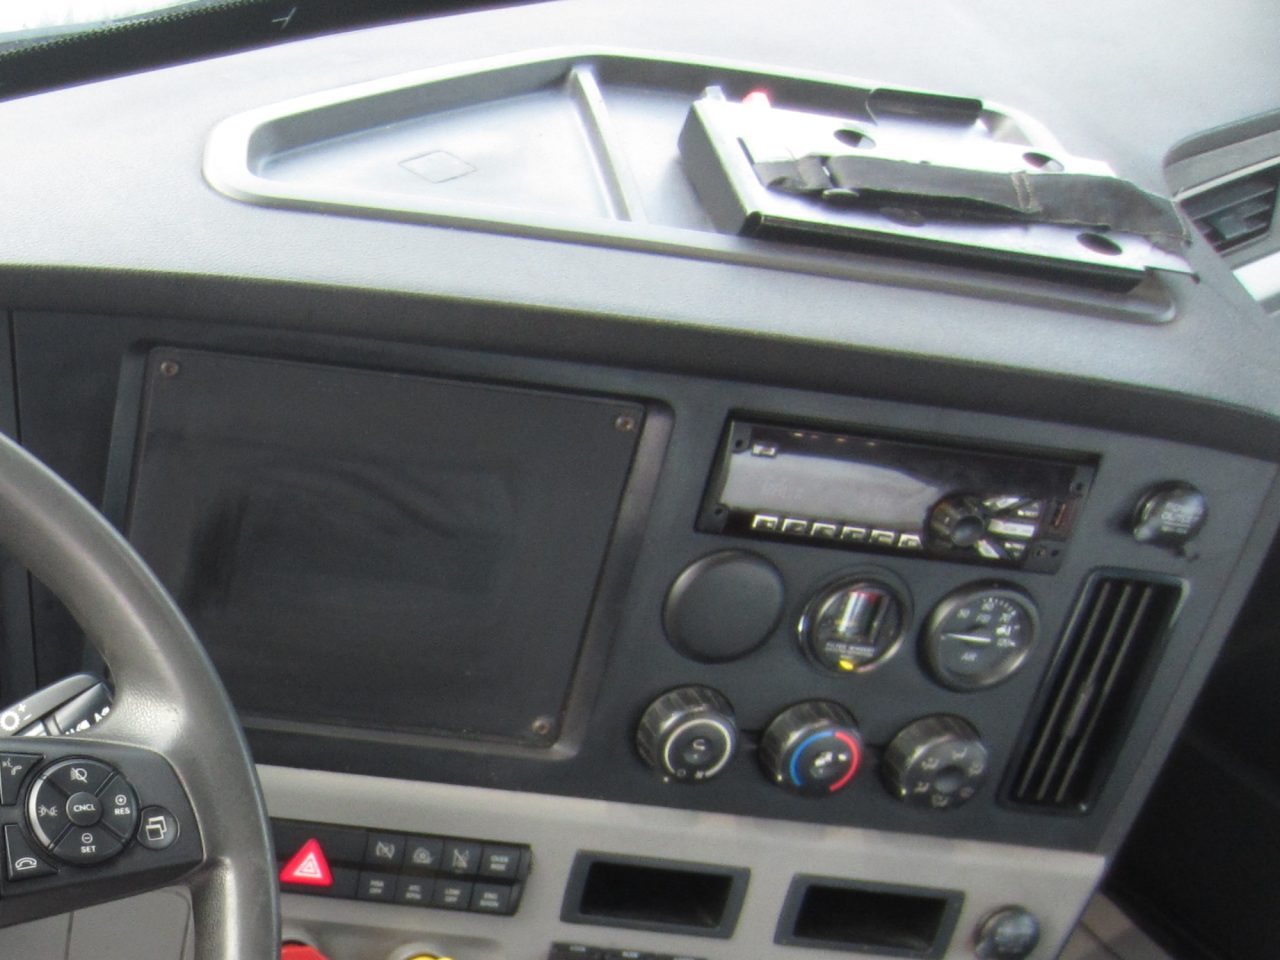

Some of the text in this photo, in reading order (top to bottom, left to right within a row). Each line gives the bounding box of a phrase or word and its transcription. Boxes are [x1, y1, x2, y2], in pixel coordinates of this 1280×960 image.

[73, 803, 96, 813] CNCL
[114, 807, 131, 817] RES
[80, 845, 96, 854] SET
